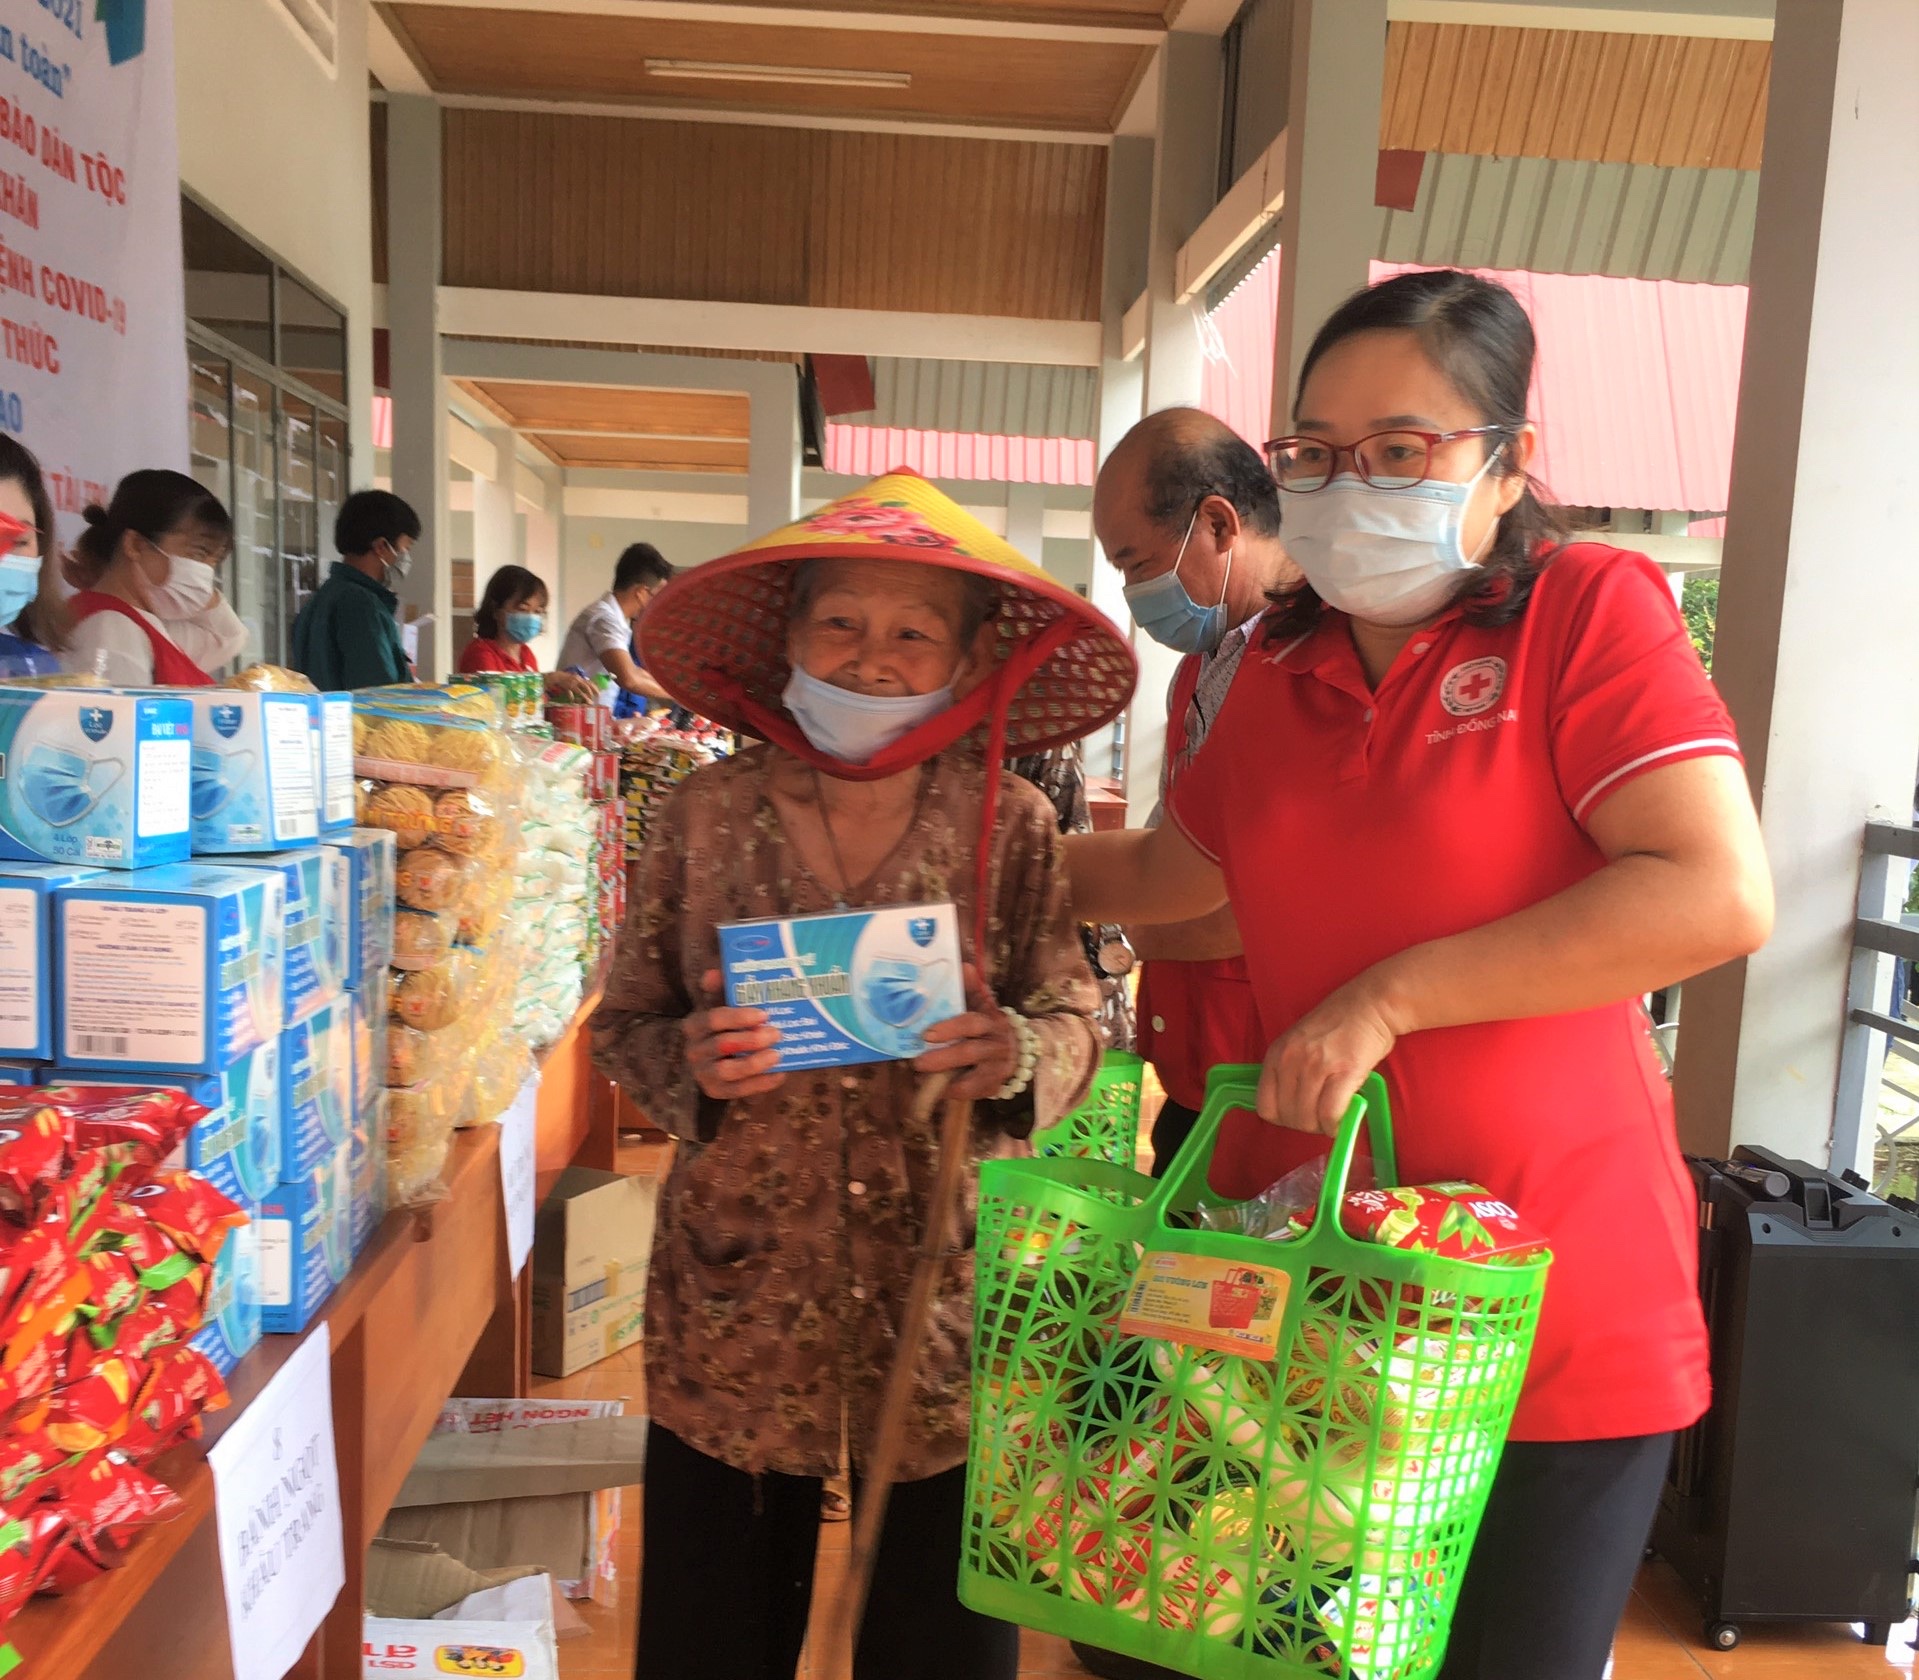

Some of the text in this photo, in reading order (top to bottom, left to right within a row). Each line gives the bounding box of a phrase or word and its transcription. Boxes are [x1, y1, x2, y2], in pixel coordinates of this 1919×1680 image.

[37, 0, 83, 40] 021
[0, 169, 39, 231] HĂN
[80, 151, 125, 206] TỘC
[1456, 718, 1496, 734] ĐỒNG
